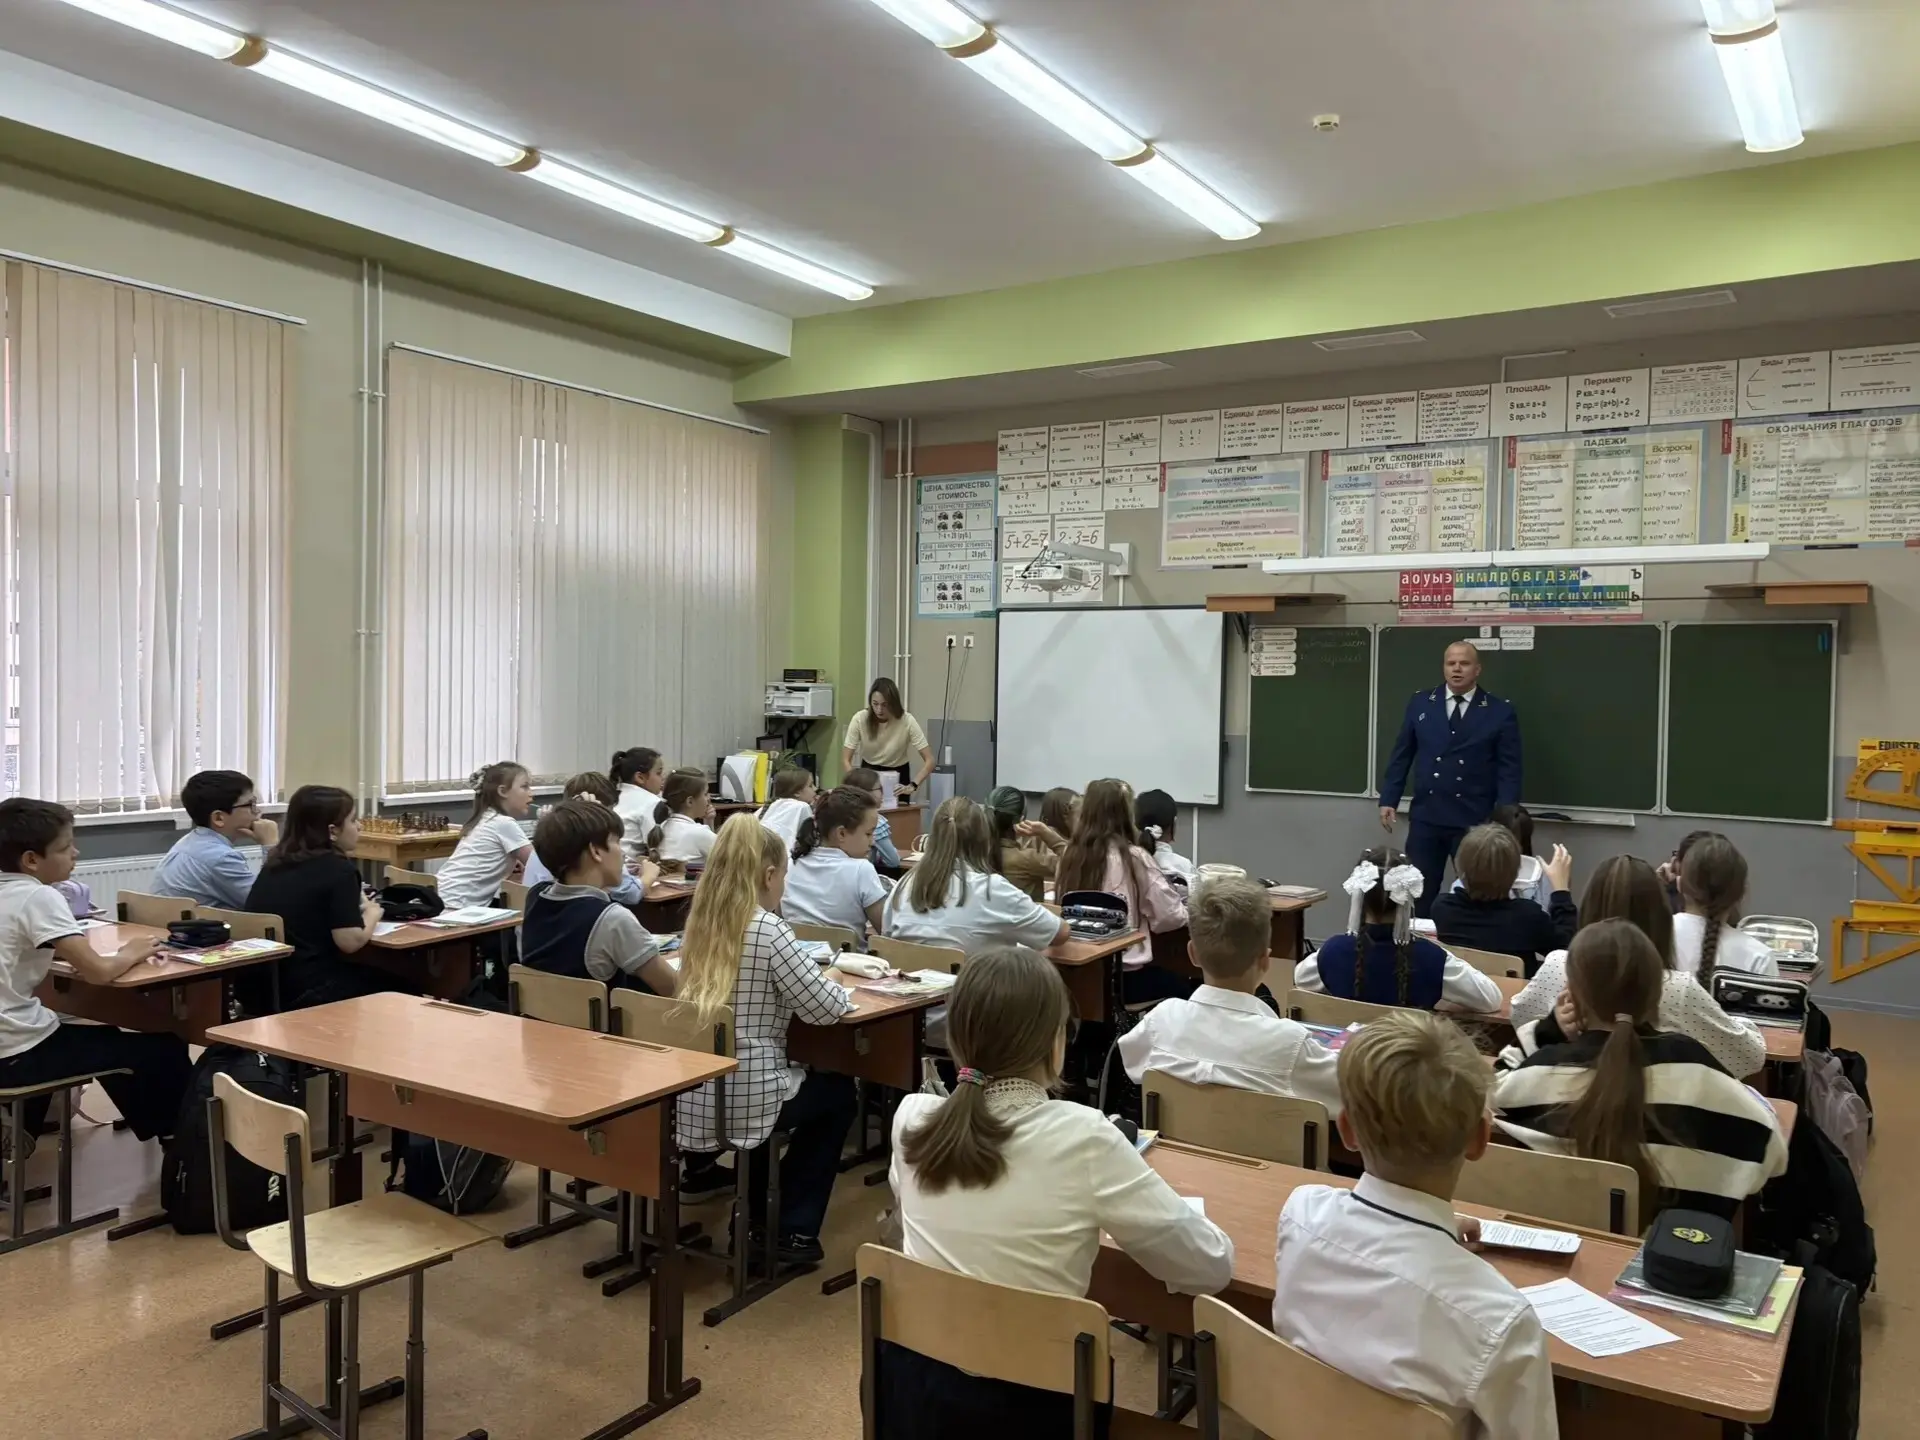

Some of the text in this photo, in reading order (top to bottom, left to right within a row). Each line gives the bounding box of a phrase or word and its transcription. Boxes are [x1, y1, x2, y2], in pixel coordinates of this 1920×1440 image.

[1787, 356, 1812, 365] углов
[1584, 375, 1632, 386] Периметр
[1506, 385, 1551, 394] Площадь
[1420, 389, 1488, 400] Единицы площади
[1353, 399, 1382, 407] Единицы
[1224, 409, 1280, 419] Единицы длины
[1286, 406, 1318, 414] Единицы
[1767, 418, 1902, 434] ОКОНЧАНИЯ ГЛАГОЛОВ
[1584, 437, 1627, 446] ПАДЕЖИ
[1652, 445, 1692, 453] Вопросы
[1390, 452, 1442, 462] СКЛОНЕНИЯ
[1347, 458, 1465, 472] ИМЁН СУЩЕСТВИТЕЛЬНЫХ
[1208, 467, 1232, 475] ЧАСТИ
[937, 492, 977, 500] СТОИМОСТЬ
[268, 1173, 280, 1202] OK
